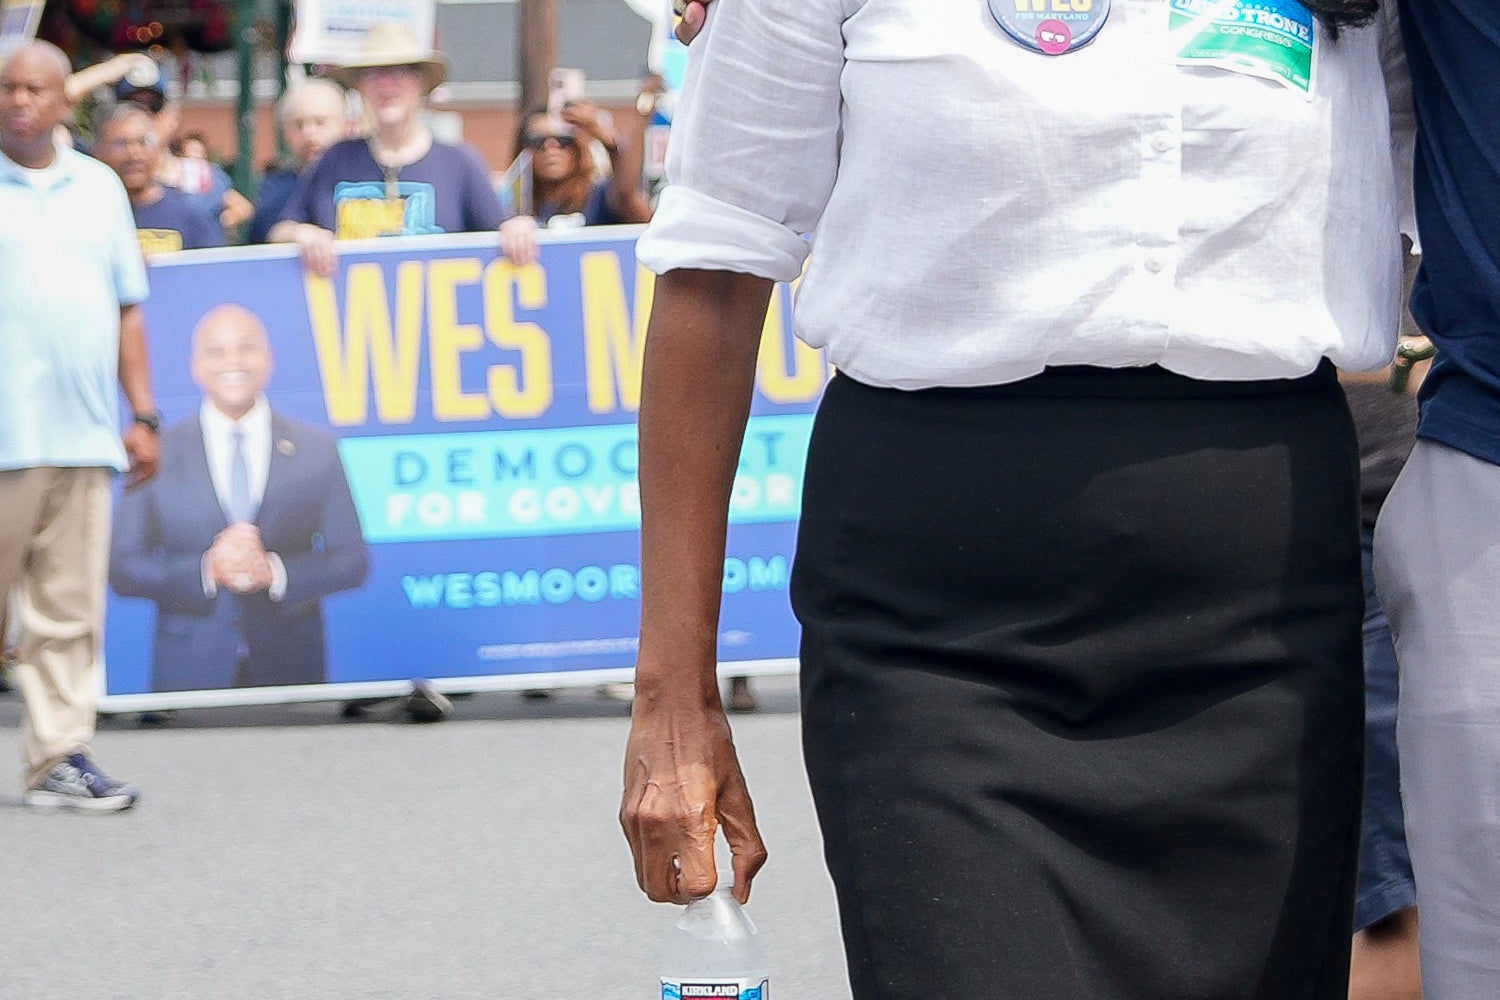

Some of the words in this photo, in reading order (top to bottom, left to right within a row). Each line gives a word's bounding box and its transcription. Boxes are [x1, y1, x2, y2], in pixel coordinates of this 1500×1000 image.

[1036, 12, 1090, 22] MARYLAND
[1240, 8, 1310, 42] TRONE
[1219, 25, 1293, 48] CONGRESS
[303, 256, 554, 428] WES
[386, 489, 490, 529] FOR
[681, 985, 738, 997] KIRKLAND
